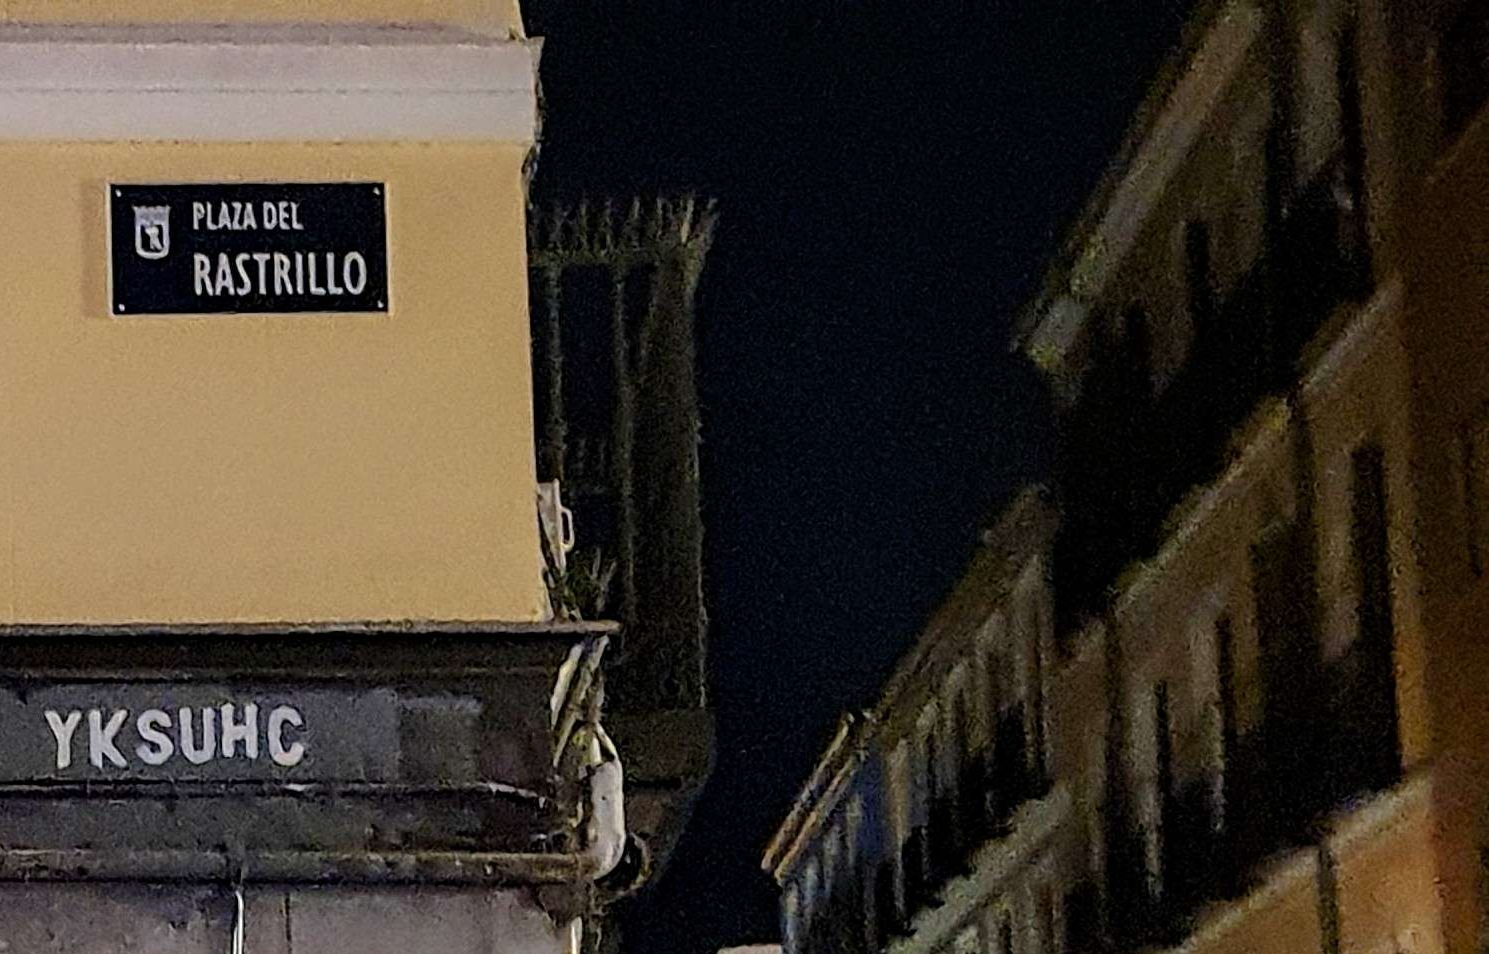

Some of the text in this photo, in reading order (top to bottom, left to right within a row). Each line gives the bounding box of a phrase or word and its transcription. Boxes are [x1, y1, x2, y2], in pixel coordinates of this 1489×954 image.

[192, 201, 305, 231] PLAZA DEL
[193, 250, 368, 296] RASTRILLO
[44, 702, 306, 768] YKSUHC
